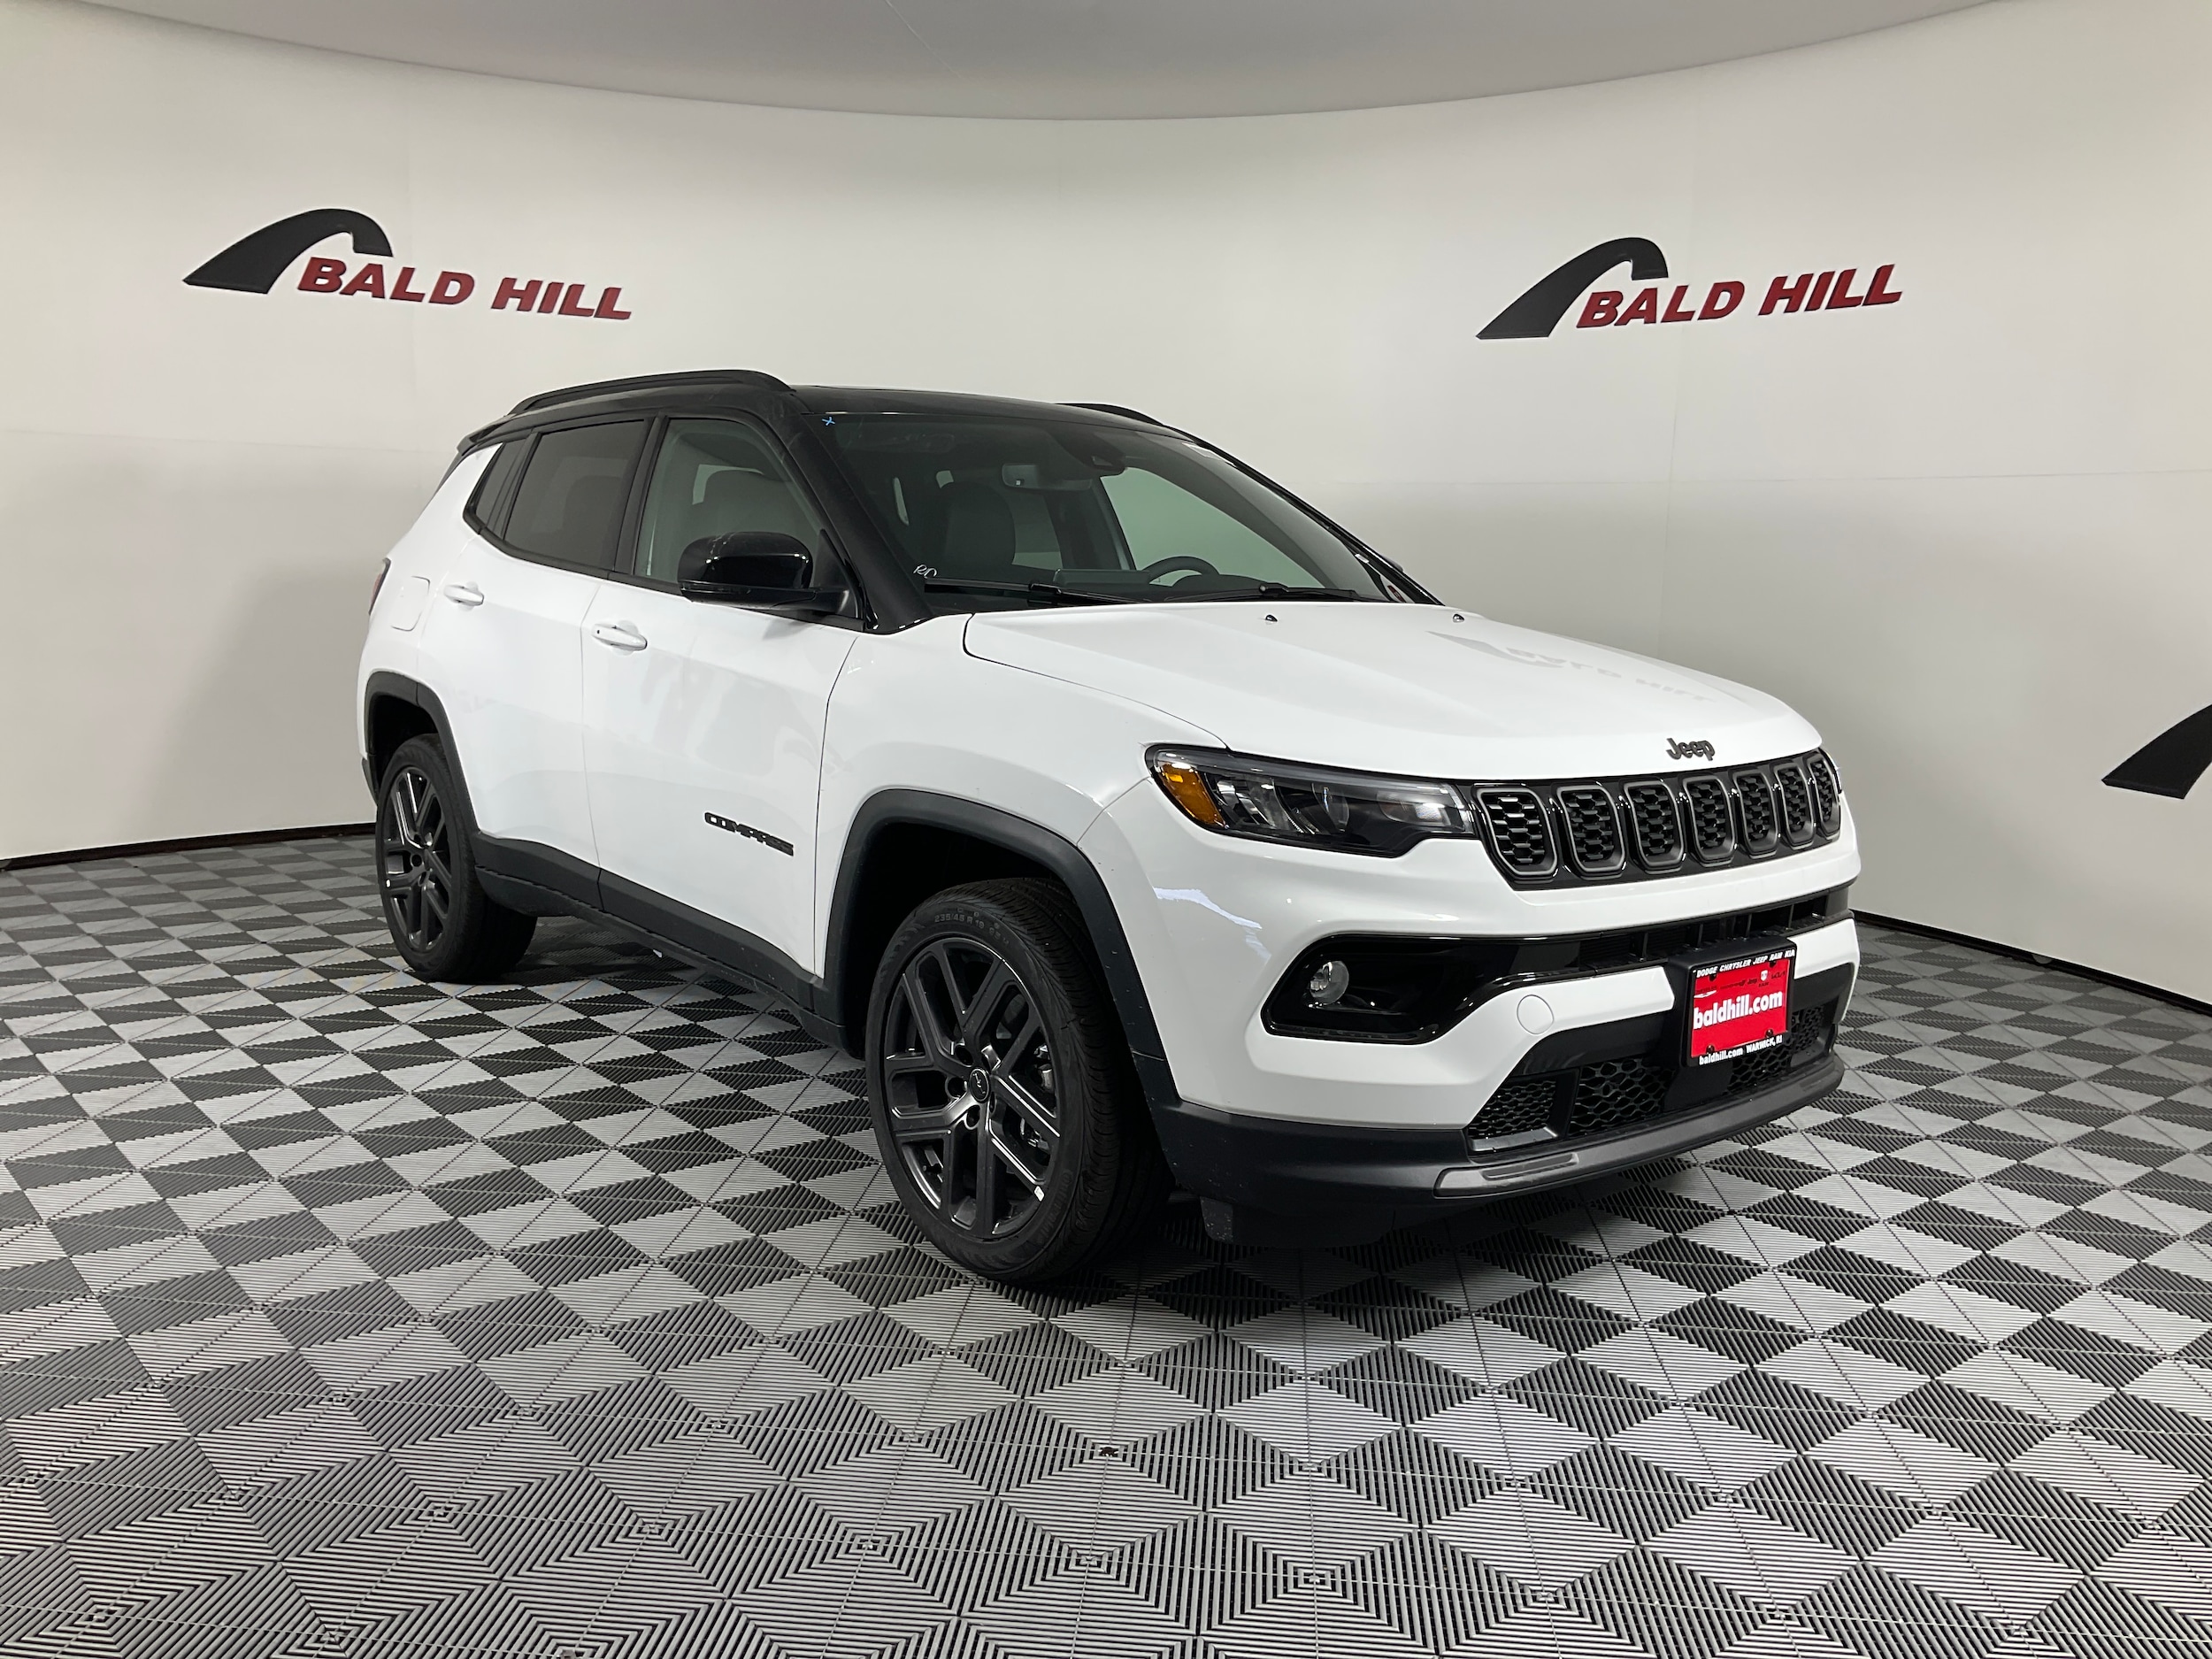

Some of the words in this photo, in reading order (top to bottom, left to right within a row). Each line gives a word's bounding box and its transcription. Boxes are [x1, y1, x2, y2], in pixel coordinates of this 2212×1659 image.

[297, 257, 474, 304] BALD
[491, 277, 632, 319] HILL
[1576, 280, 1745, 328] BALD
[1758, 264, 1902, 316] HILL
[1665, 737, 1716, 761] Jeep
[1696, 965, 1718, 978] DODGE
[1719, 959, 1752, 972] CHRYSLER
[1753, 956, 1768, 964] JEEP
[1769, 952, 1783, 961] RAM
[1694, 991, 1783, 1030] baldhill.com
[1699, 1047, 1743, 1065] baldhill.com
[1776, 1034, 1783, 1044] RI
